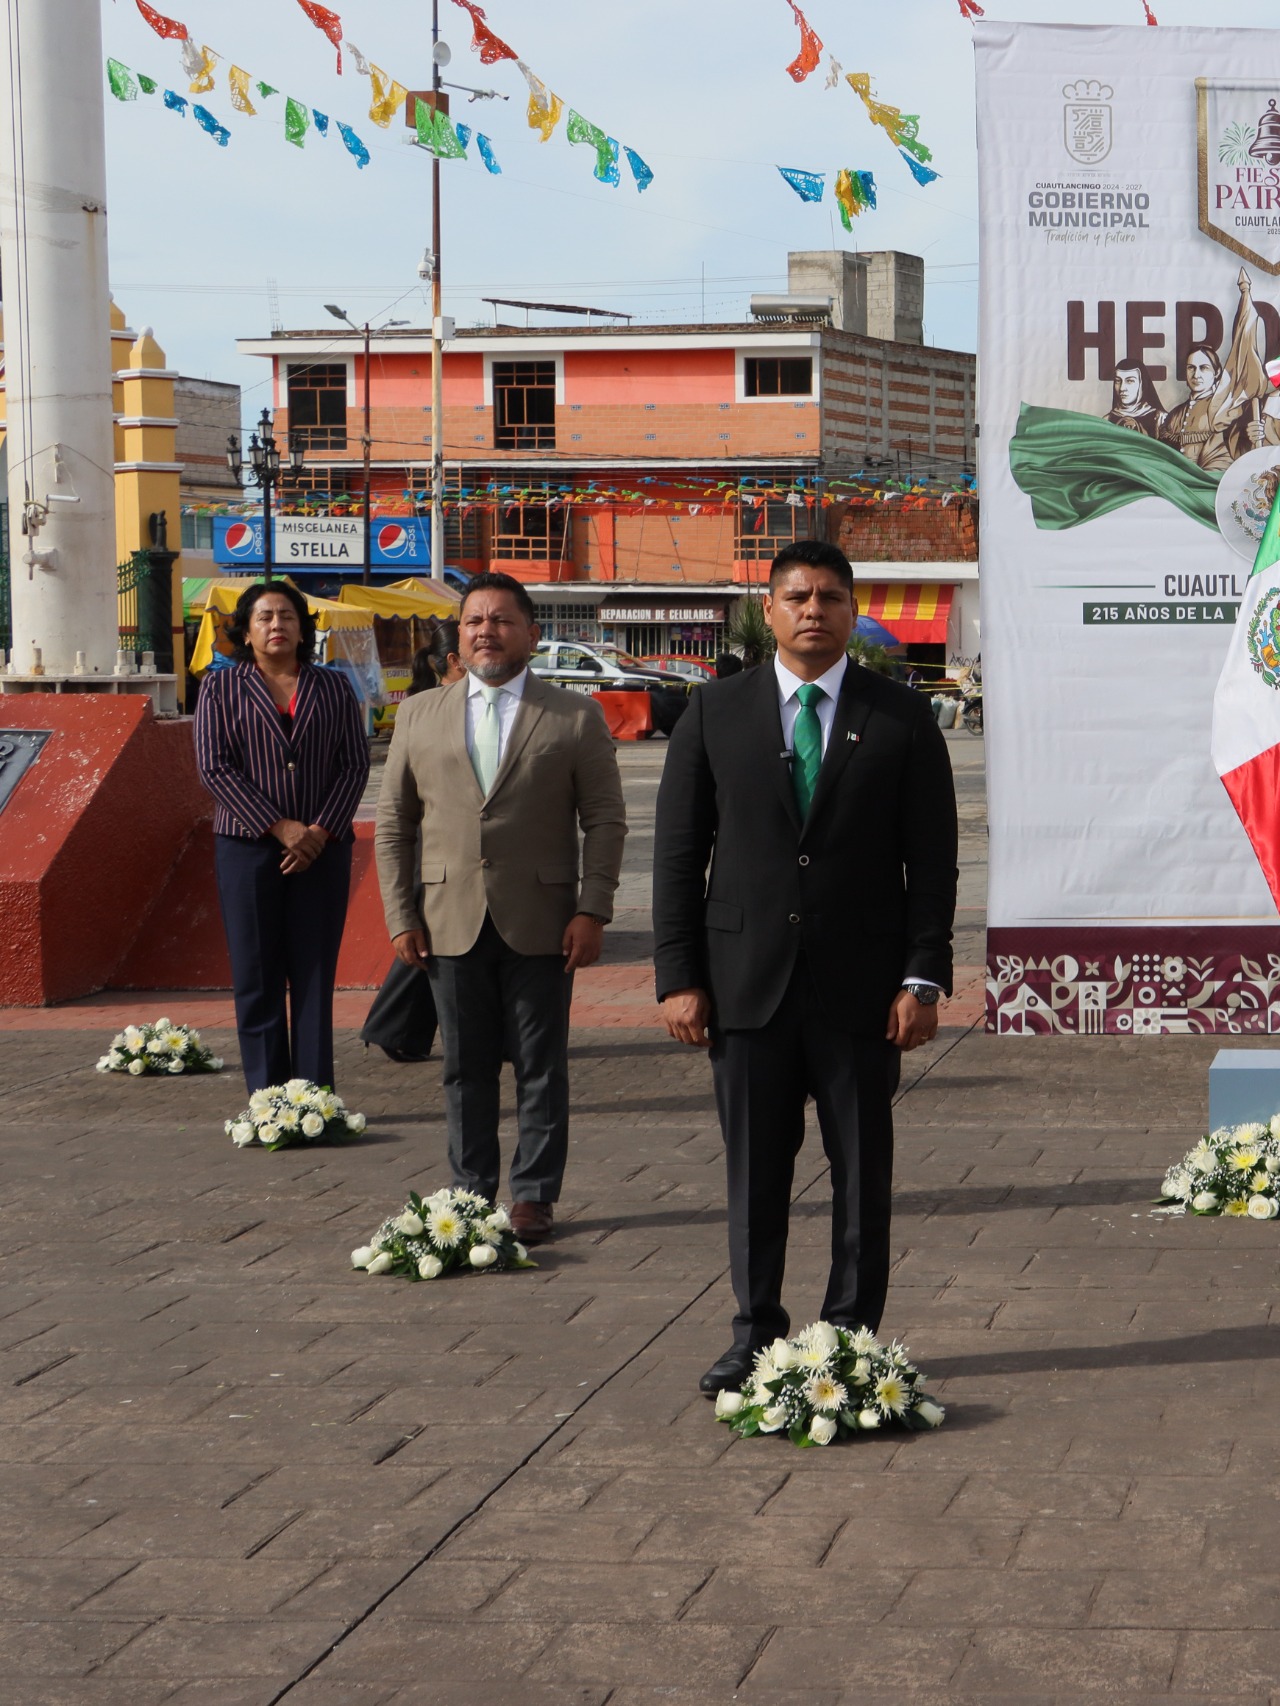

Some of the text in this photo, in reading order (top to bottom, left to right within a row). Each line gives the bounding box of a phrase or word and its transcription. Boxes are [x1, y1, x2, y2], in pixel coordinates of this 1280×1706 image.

[1036, 182, 1101, 190] CUAUTLANCINGO
[1028, 191, 1150, 210] GOBIERNO
[1028, 211, 1150, 228] MUNICIPAL
[1044, 228, 1089, 246] Tradición
[1093, 233, 1101, 247] y
[282, 522, 358, 535] MISCELANEA
[254, 523, 263, 556] pepsi
[408, 524, 418, 557] pepsi
[290, 542, 350, 558] STELLA
[1164, 574, 1250, 597] CUAUTL
[601, 608, 714, 621] REPARACION DE CELULARES
[1092, 606, 1119, 620] 215
[1124, 604, 1170, 620] AÑOS
[1175, 606, 1197, 620] DE
[1202, 606, 1225, 620] LA
